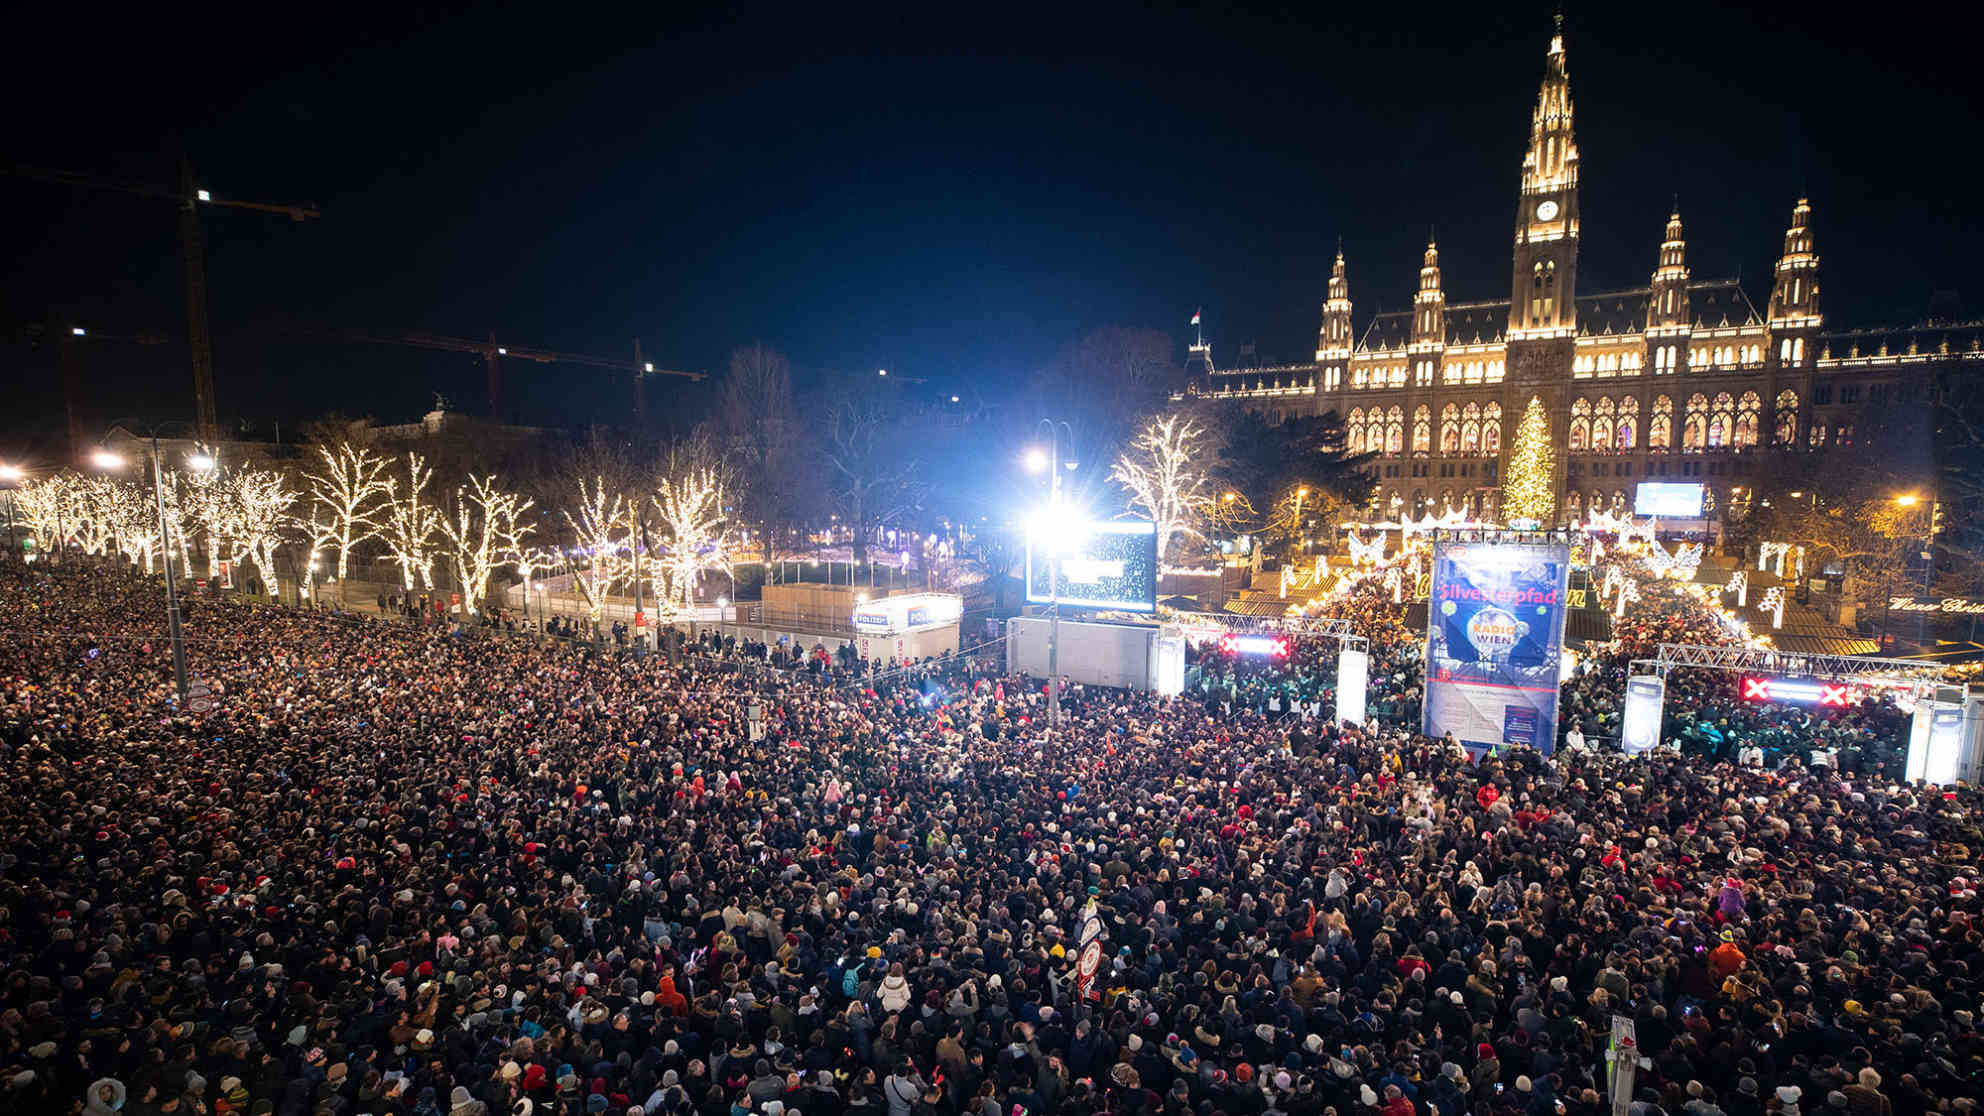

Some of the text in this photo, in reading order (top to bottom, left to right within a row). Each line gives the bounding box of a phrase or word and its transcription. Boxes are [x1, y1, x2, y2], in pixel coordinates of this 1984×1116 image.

[1439, 584, 1557, 605] Silvesterpfad
[1888, 597, 1941, 610] Wiener
[1473, 623, 1516, 635] RADIO
[1477, 635, 1511, 645] WIEN
